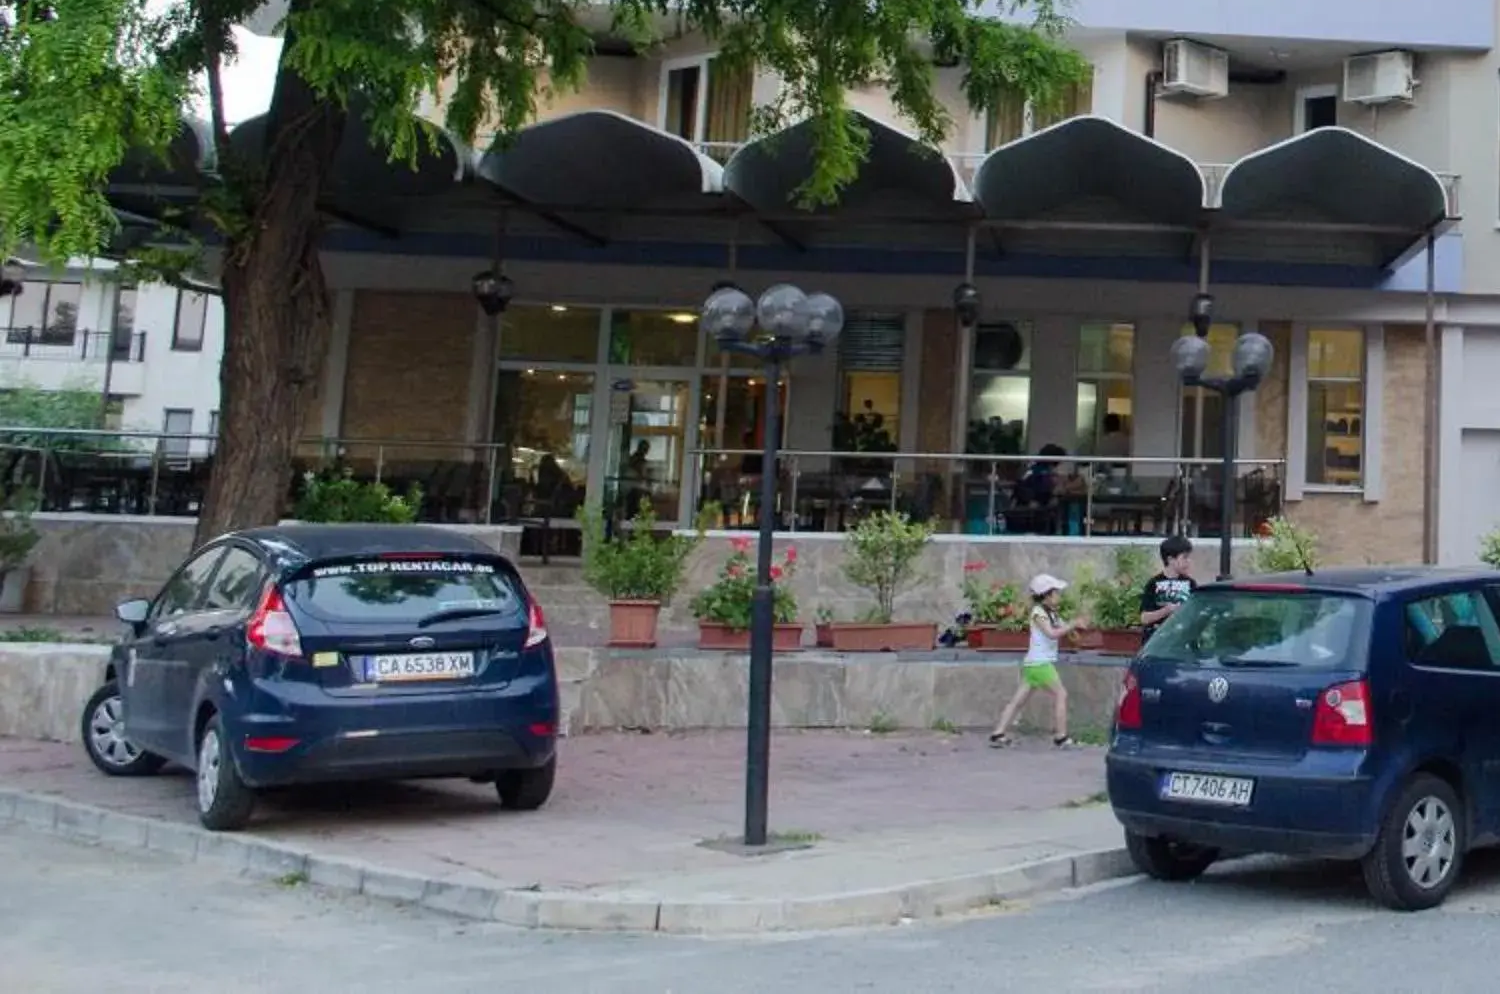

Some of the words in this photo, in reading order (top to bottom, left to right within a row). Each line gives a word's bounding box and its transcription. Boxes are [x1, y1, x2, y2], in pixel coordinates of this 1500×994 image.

[378, 658, 400, 675] CA
[405, 657, 446, 673] 6538
[449, 655, 472, 671] XM
[1191, 778, 1226, 799] 7406
[1229, 781, 1249, 801] AH
